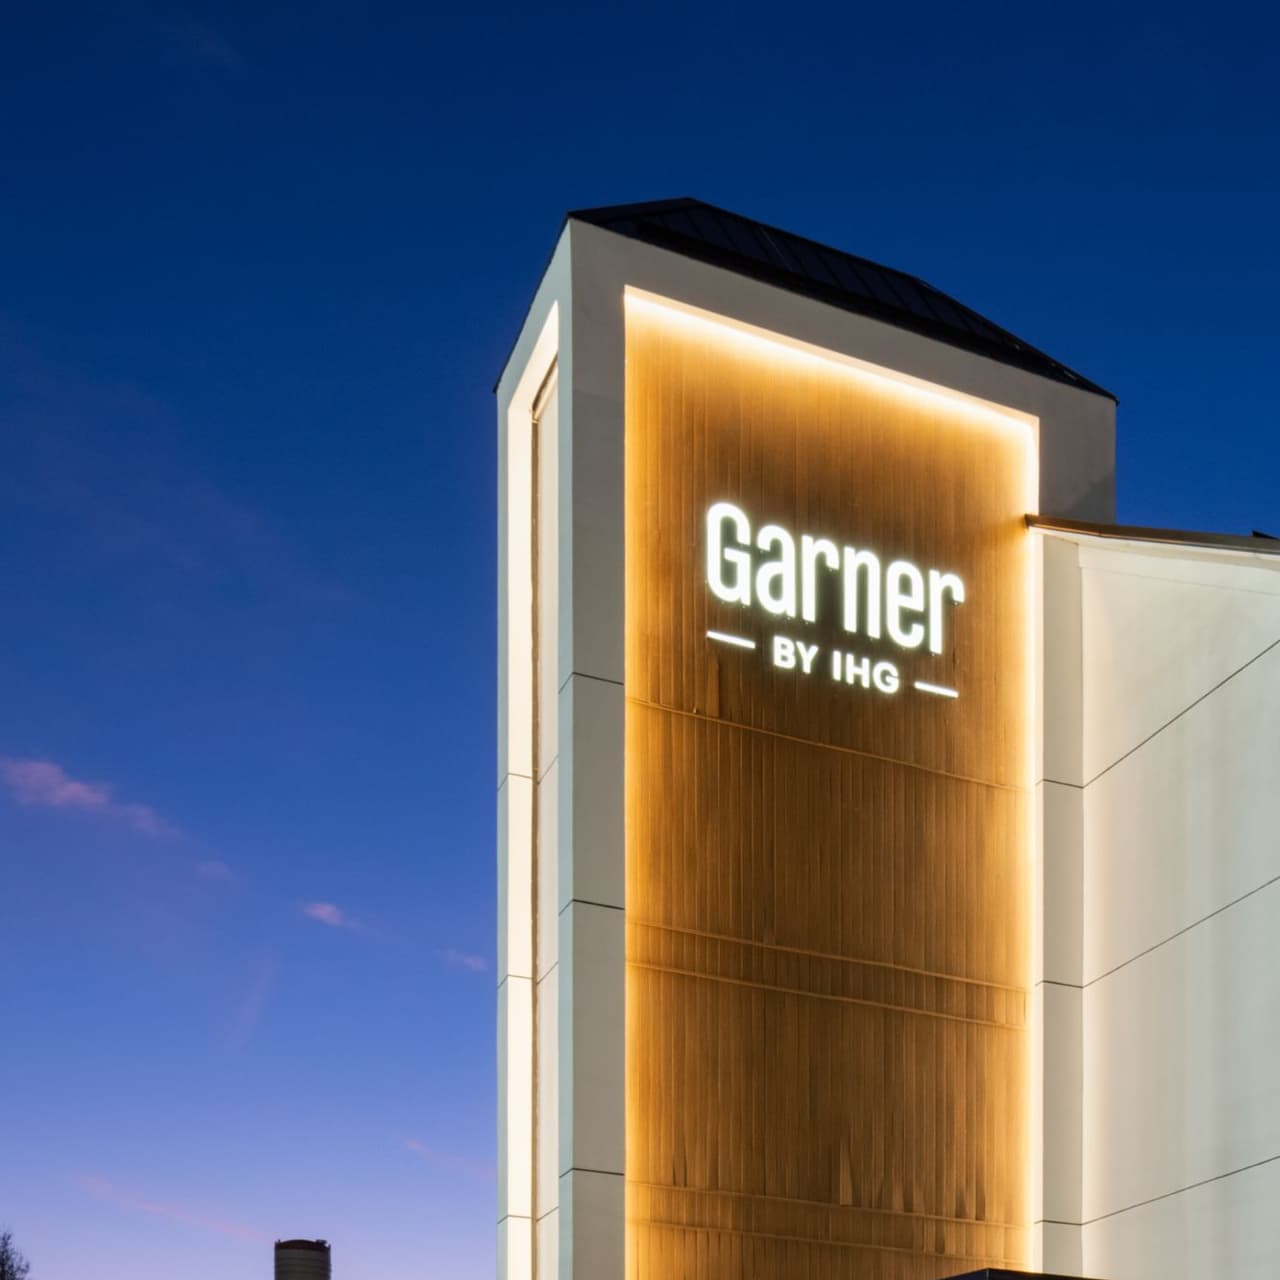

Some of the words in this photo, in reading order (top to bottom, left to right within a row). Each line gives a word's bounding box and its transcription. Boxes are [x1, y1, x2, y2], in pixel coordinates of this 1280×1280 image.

[706, 502, 965, 655] Garner
[773, 635, 818, 674] BY
[832, 650, 899, 694] IHG
